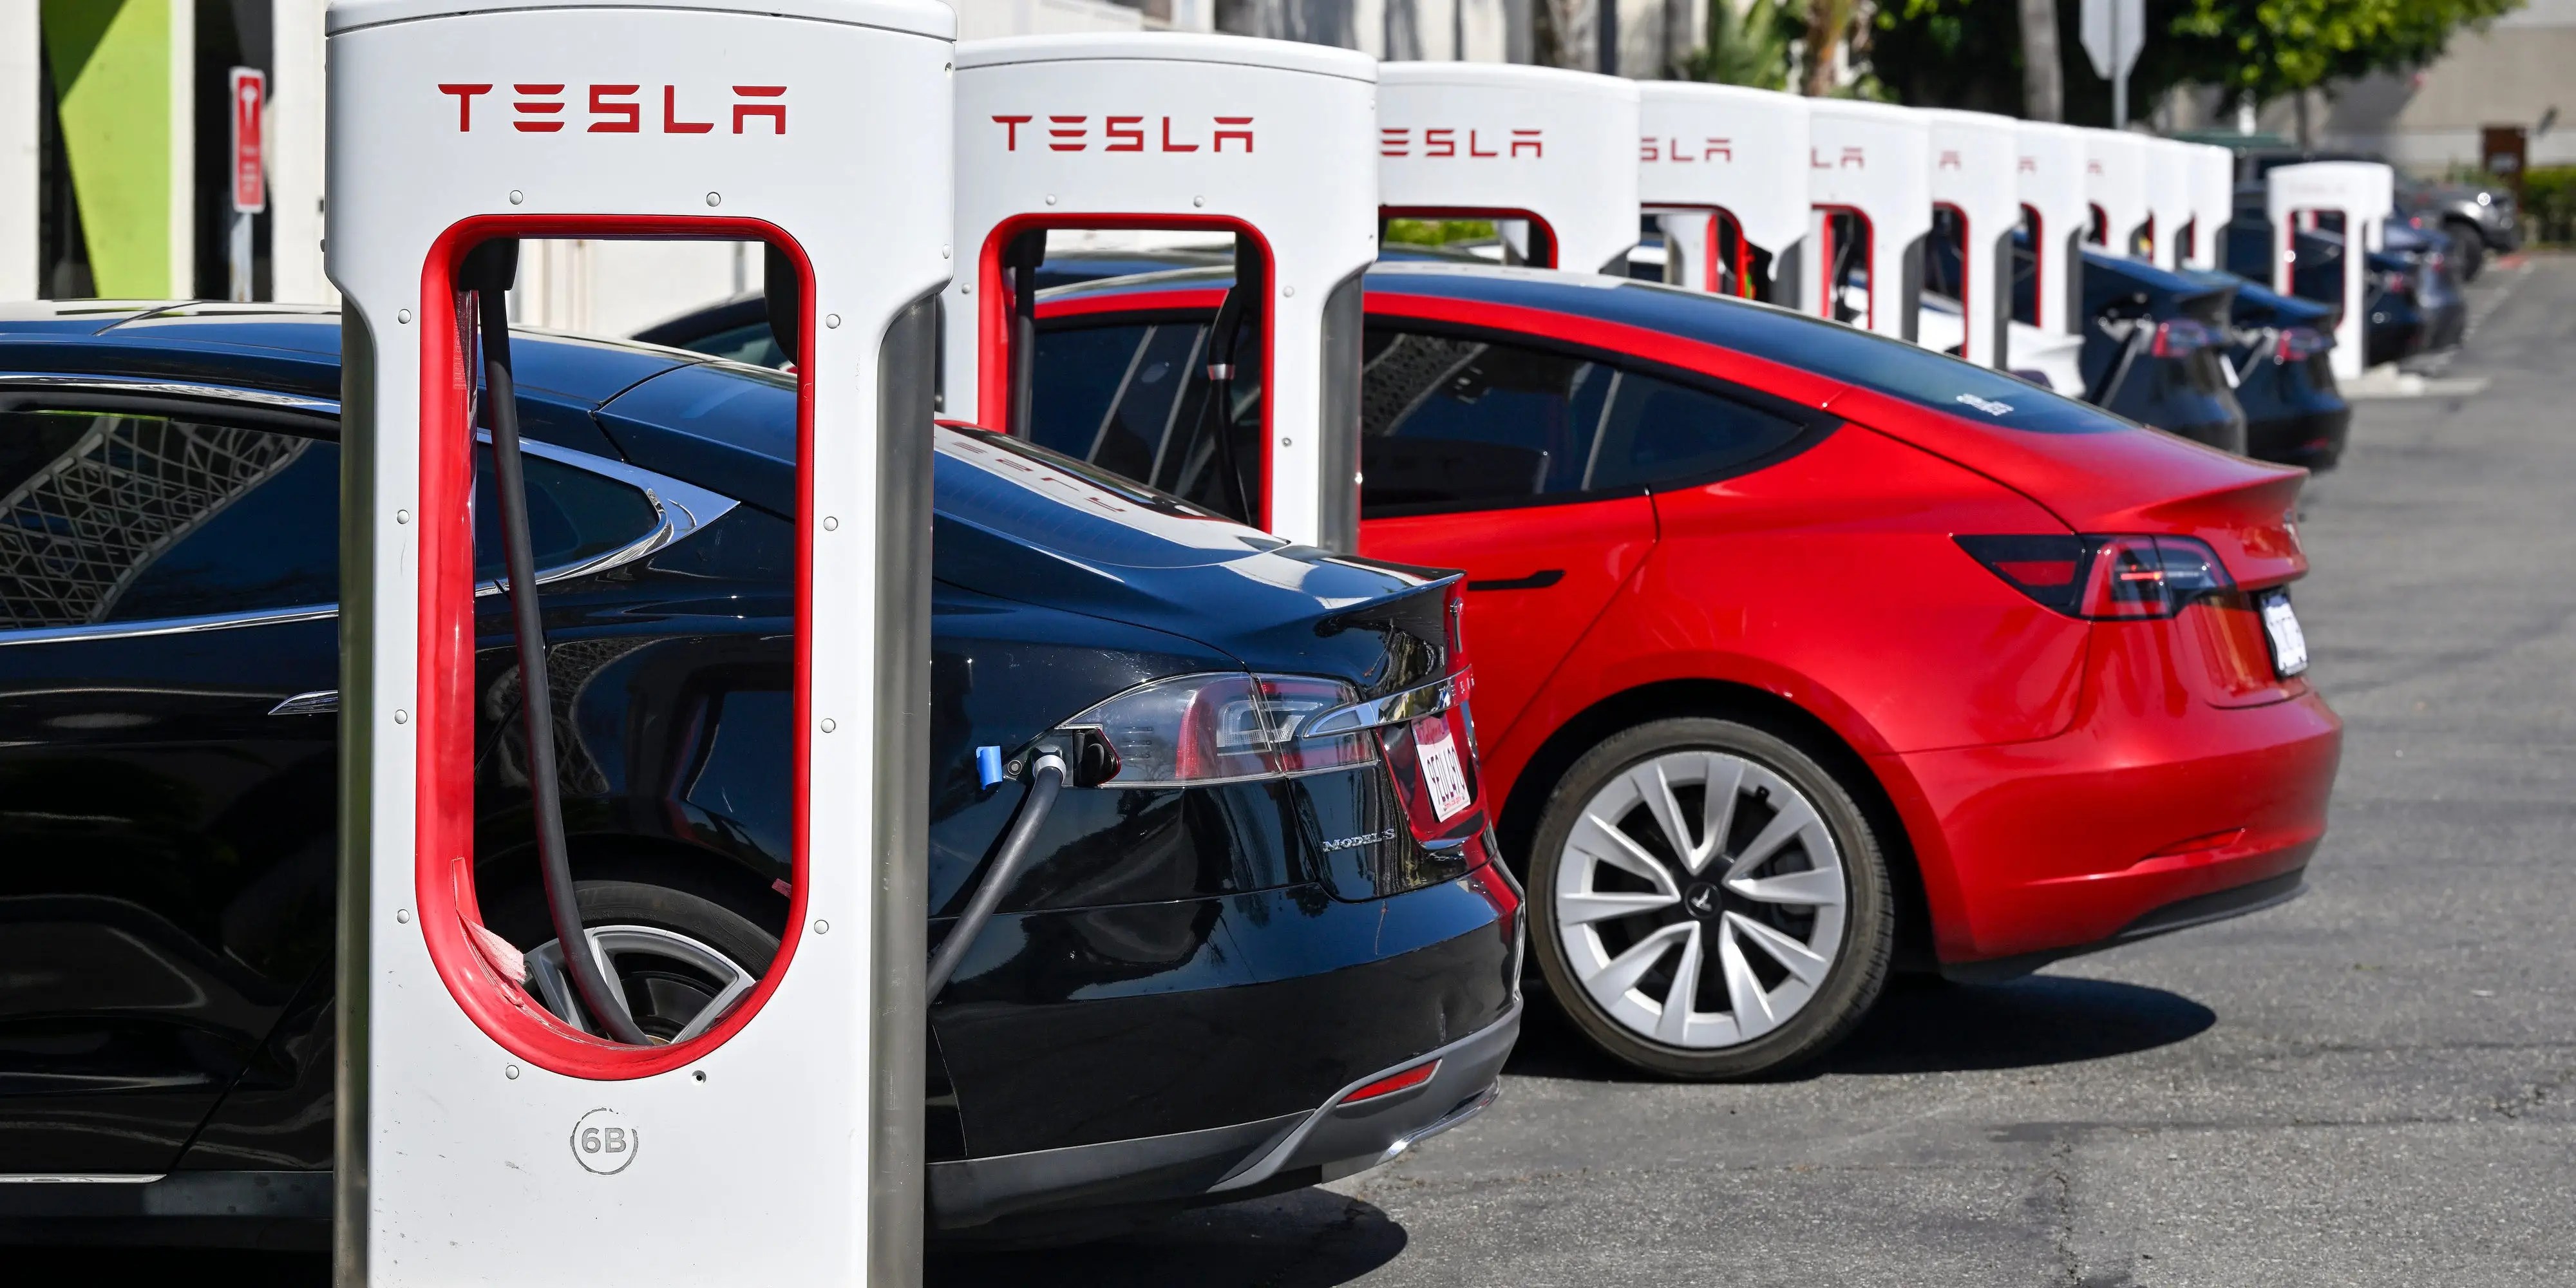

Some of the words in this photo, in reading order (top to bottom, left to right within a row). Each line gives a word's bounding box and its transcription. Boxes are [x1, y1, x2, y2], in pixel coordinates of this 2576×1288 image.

[438, 84, 787, 134] TESLA
[991, 115, 1254, 153] TESLA
[1323, 833, 1383, 851] MODEL
[1383, 828, 1396, 840] S
[582, 1127, 627, 1154] 6B
